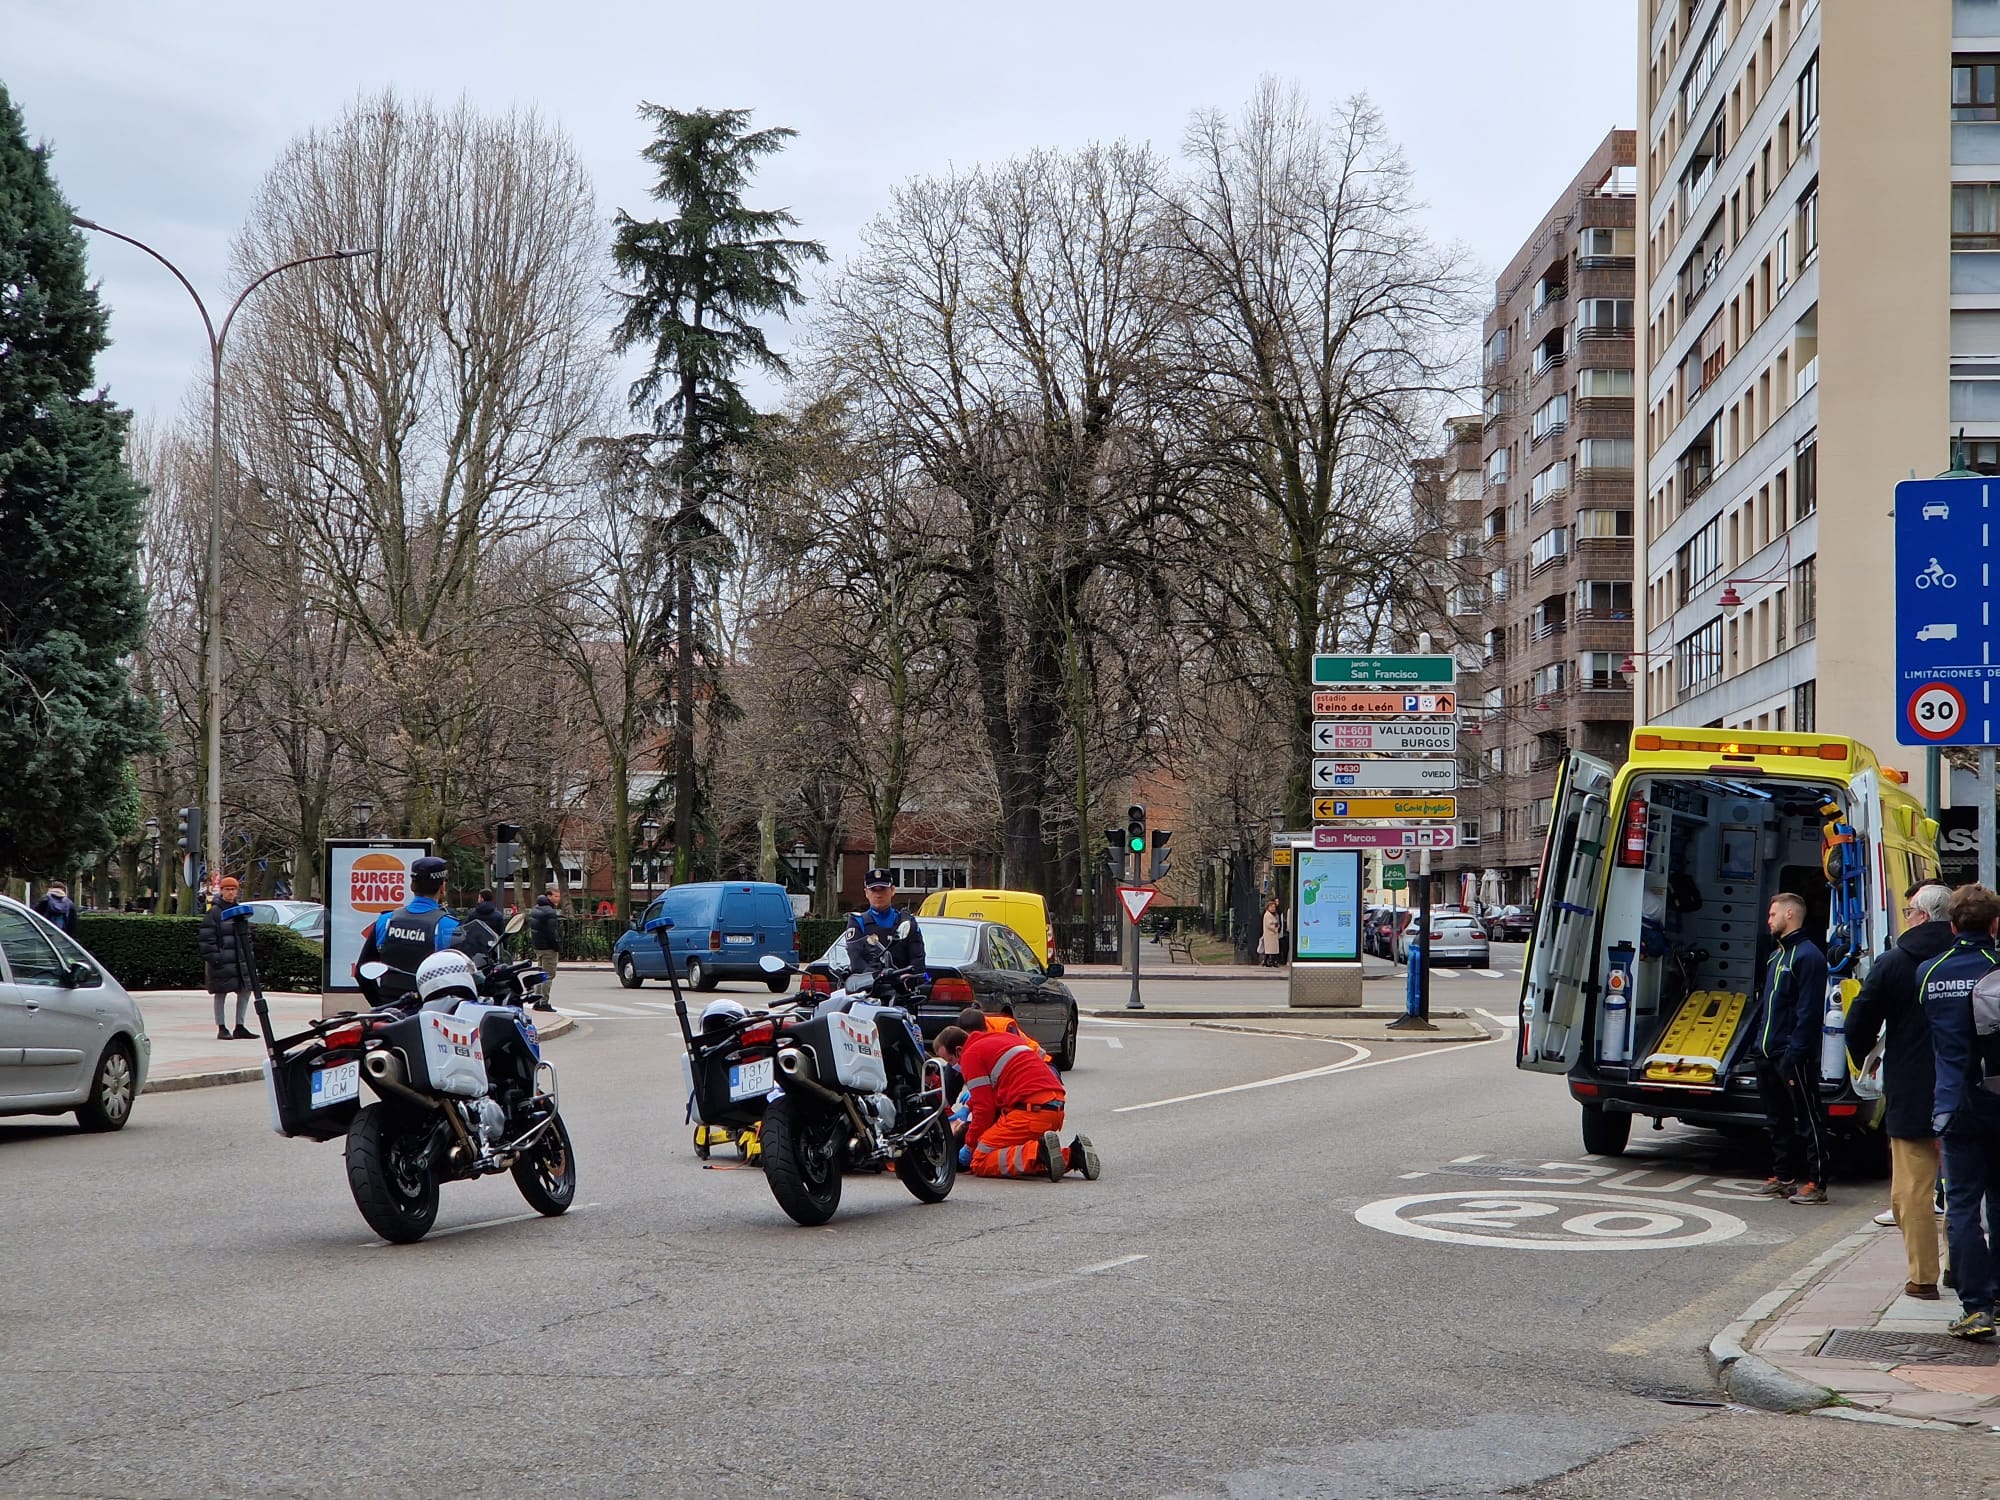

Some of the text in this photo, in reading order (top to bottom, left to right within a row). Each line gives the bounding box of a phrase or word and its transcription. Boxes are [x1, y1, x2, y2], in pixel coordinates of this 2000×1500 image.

[1351, 670, 1418, 679] San Francisco
[1904, 669, 1981, 679] LIMITACIONES
[1351, 703, 1364, 711] de
[1368, 702, 1393, 711] León
[1405, 697, 1416, 710] P
[1921, 702, 1953, 720] 30
[1339, 726, 1450, 735] N-601 VALLADOLID
[1339, 738, 1450, 748] N-120 BURGOS
[1335, 765, 1359, 773] N-630
[1336, 803, 1345, 814] P
[1319, 834, 1376, 842] San Marcos
[351, 872, 405, 884] BURGER
[351, 885, 405, 902] KING
[389, 927, 425, 942] POLICÍA
[1927, 979, 1977, 993] BOMBE
[324, 1065, 356, 1085] 7126
[742, 1061, 770, 1079] 1317
[324, 1081, 347, 1099] LCM
[742, 1077, 763, 1092] LCP
[1408, 1200, 1684, 1238] 20
